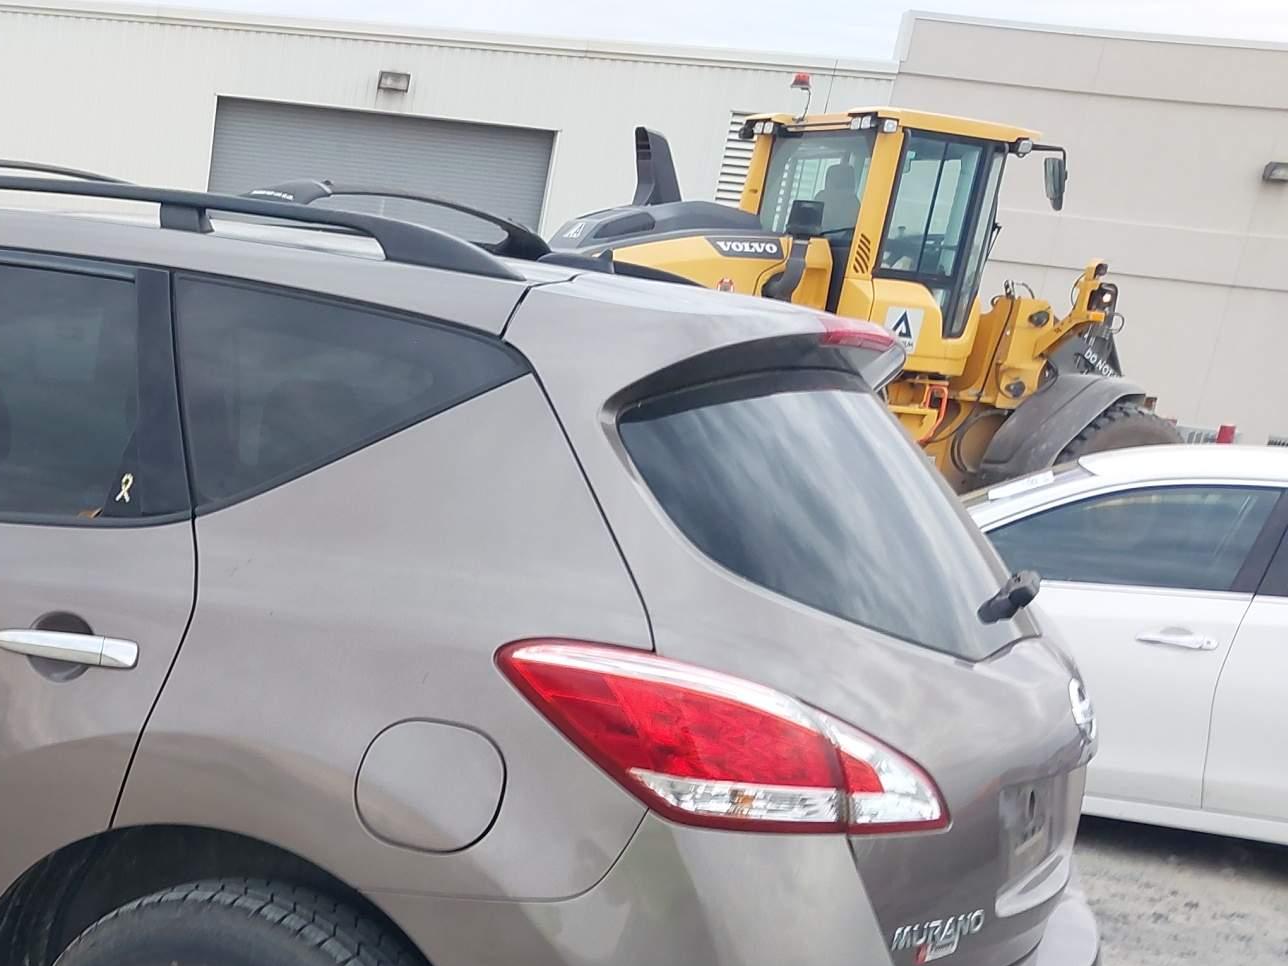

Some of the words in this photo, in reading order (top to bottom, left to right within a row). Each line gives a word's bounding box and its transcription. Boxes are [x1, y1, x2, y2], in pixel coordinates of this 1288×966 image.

[716, 240, 778, 254] VOLVO
[1084, 347, 1098, 364] DO
[891, 908, 985, 951] MURANO
